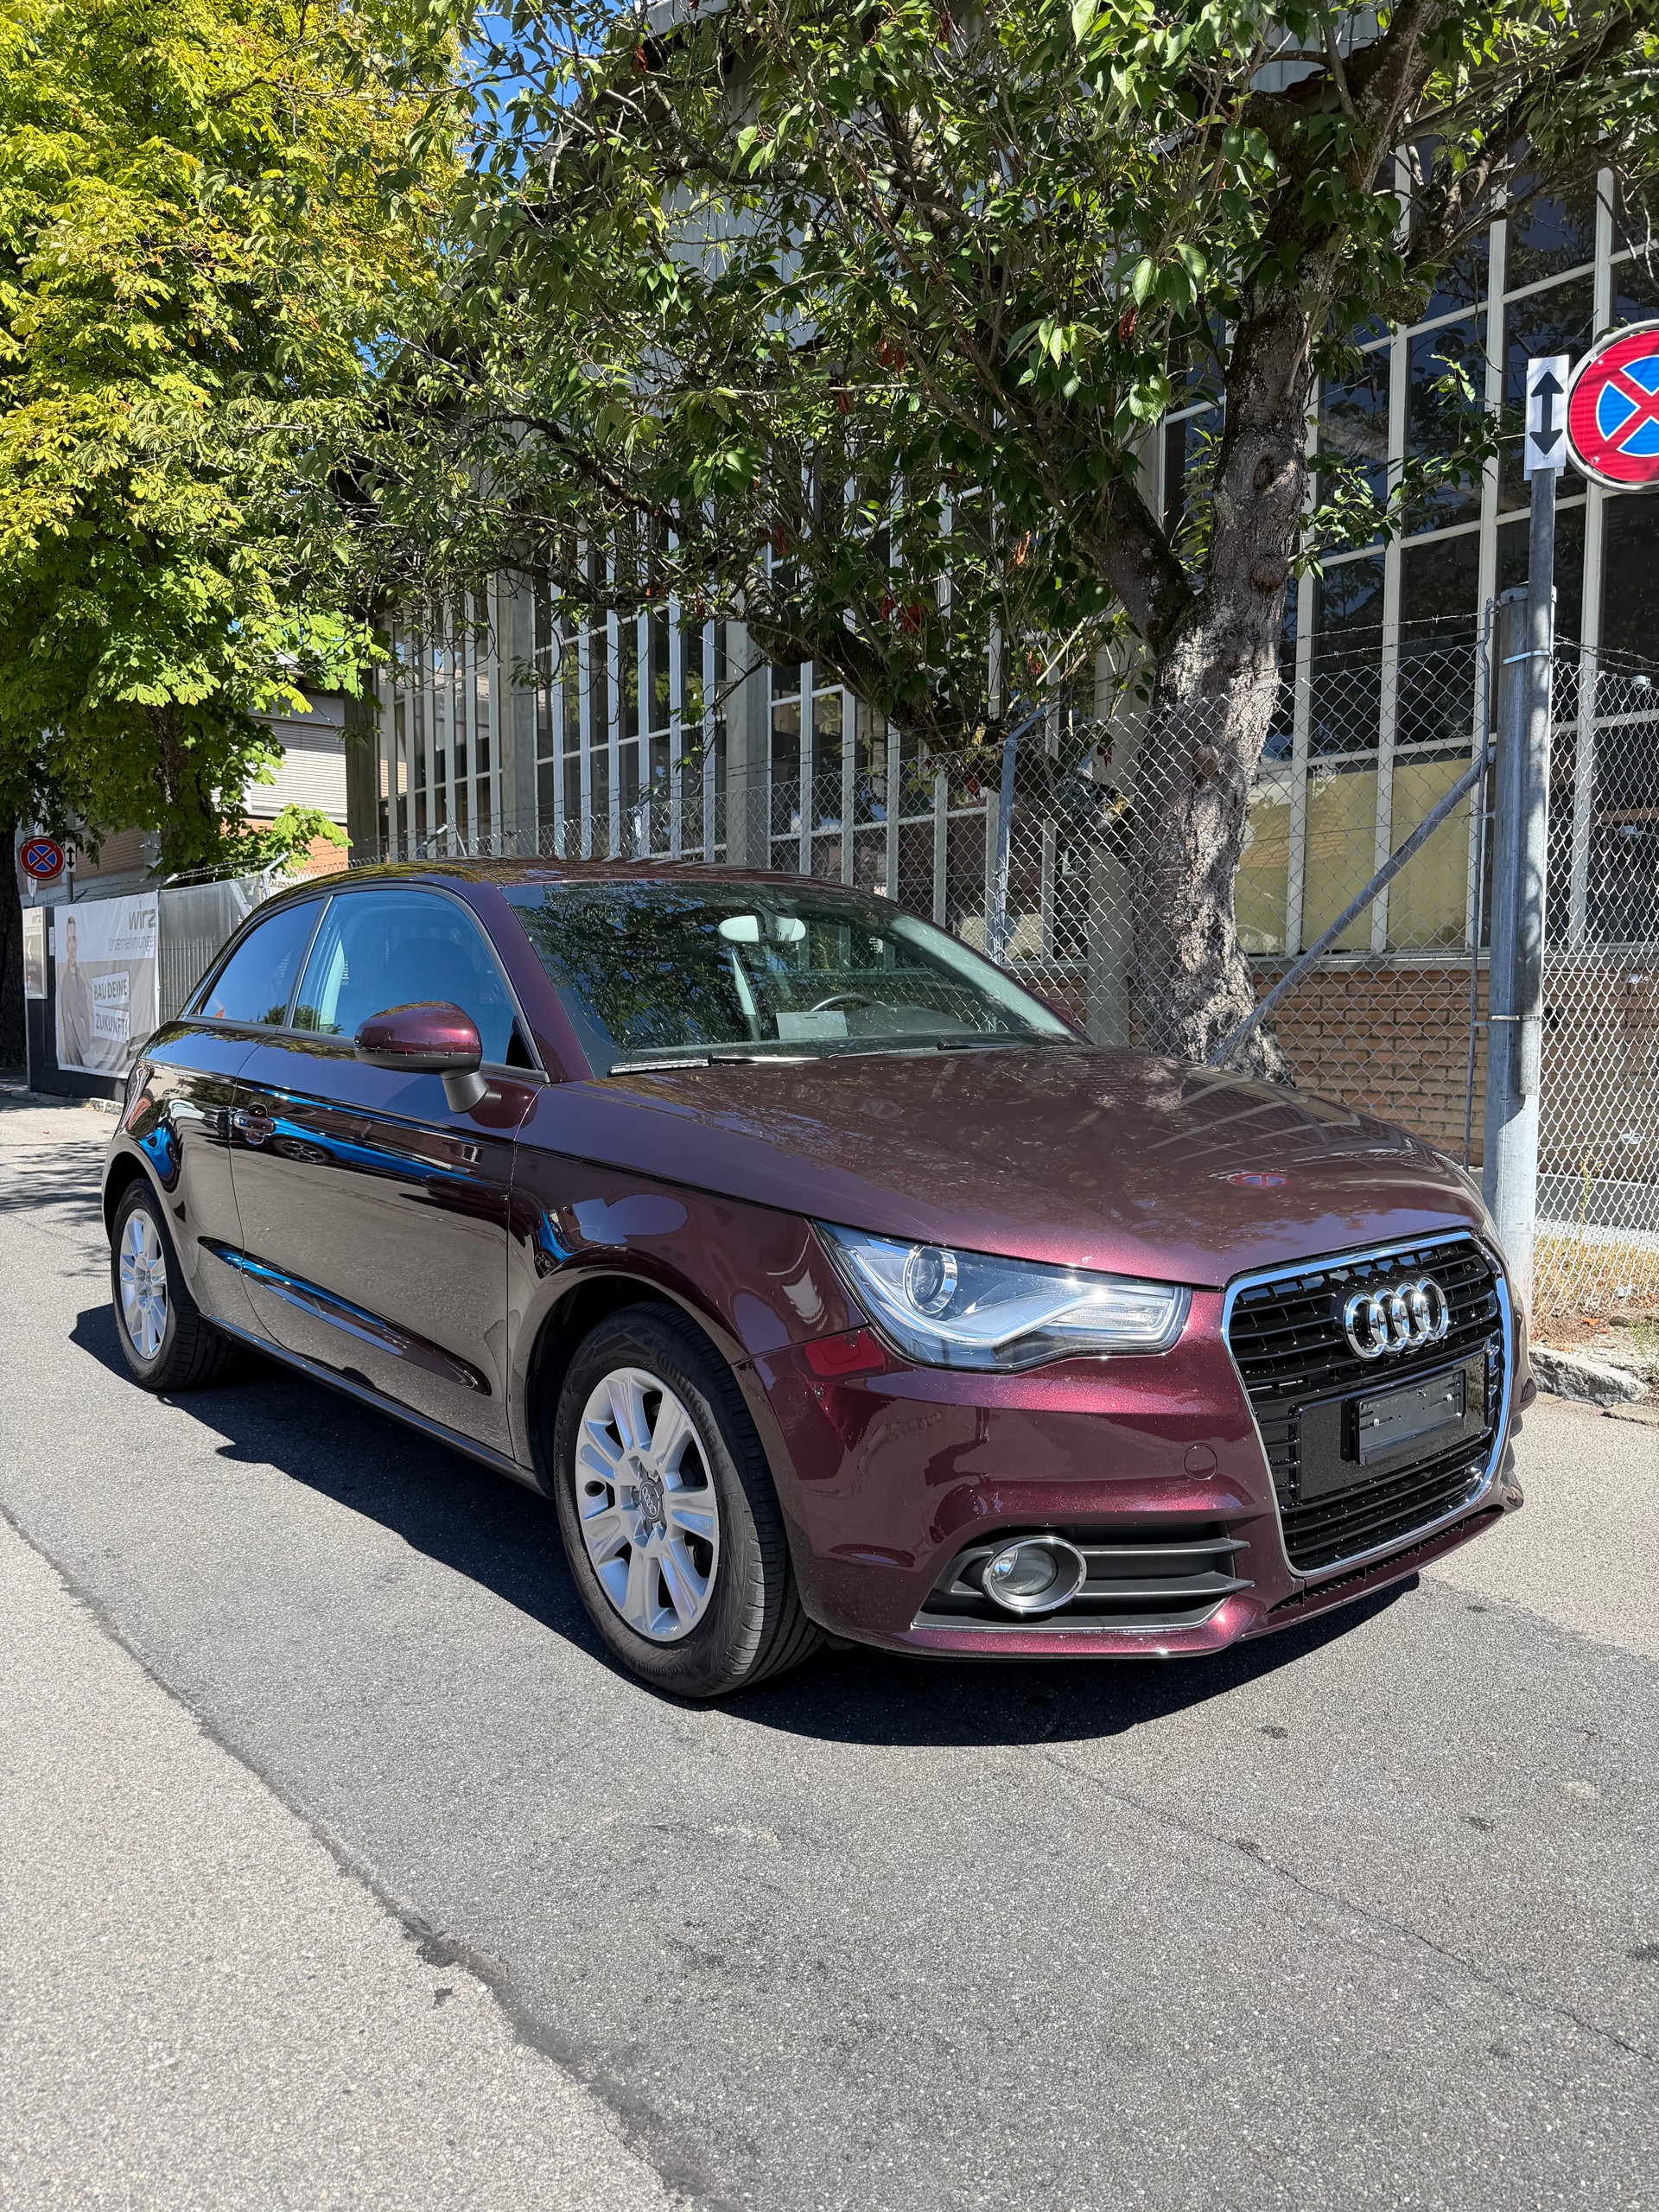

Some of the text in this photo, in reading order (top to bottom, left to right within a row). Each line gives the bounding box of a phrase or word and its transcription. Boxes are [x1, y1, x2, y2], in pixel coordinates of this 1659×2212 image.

[129, 900, 156, 931] wirz
[93, 979, 128, 1001] BAU DEINE
[95, 1013, 129, 1036] ZUKUNFT!
[655, 1350, 725, 1457] Continental
[629, 1656, 690, 1680] EcoContact 6
